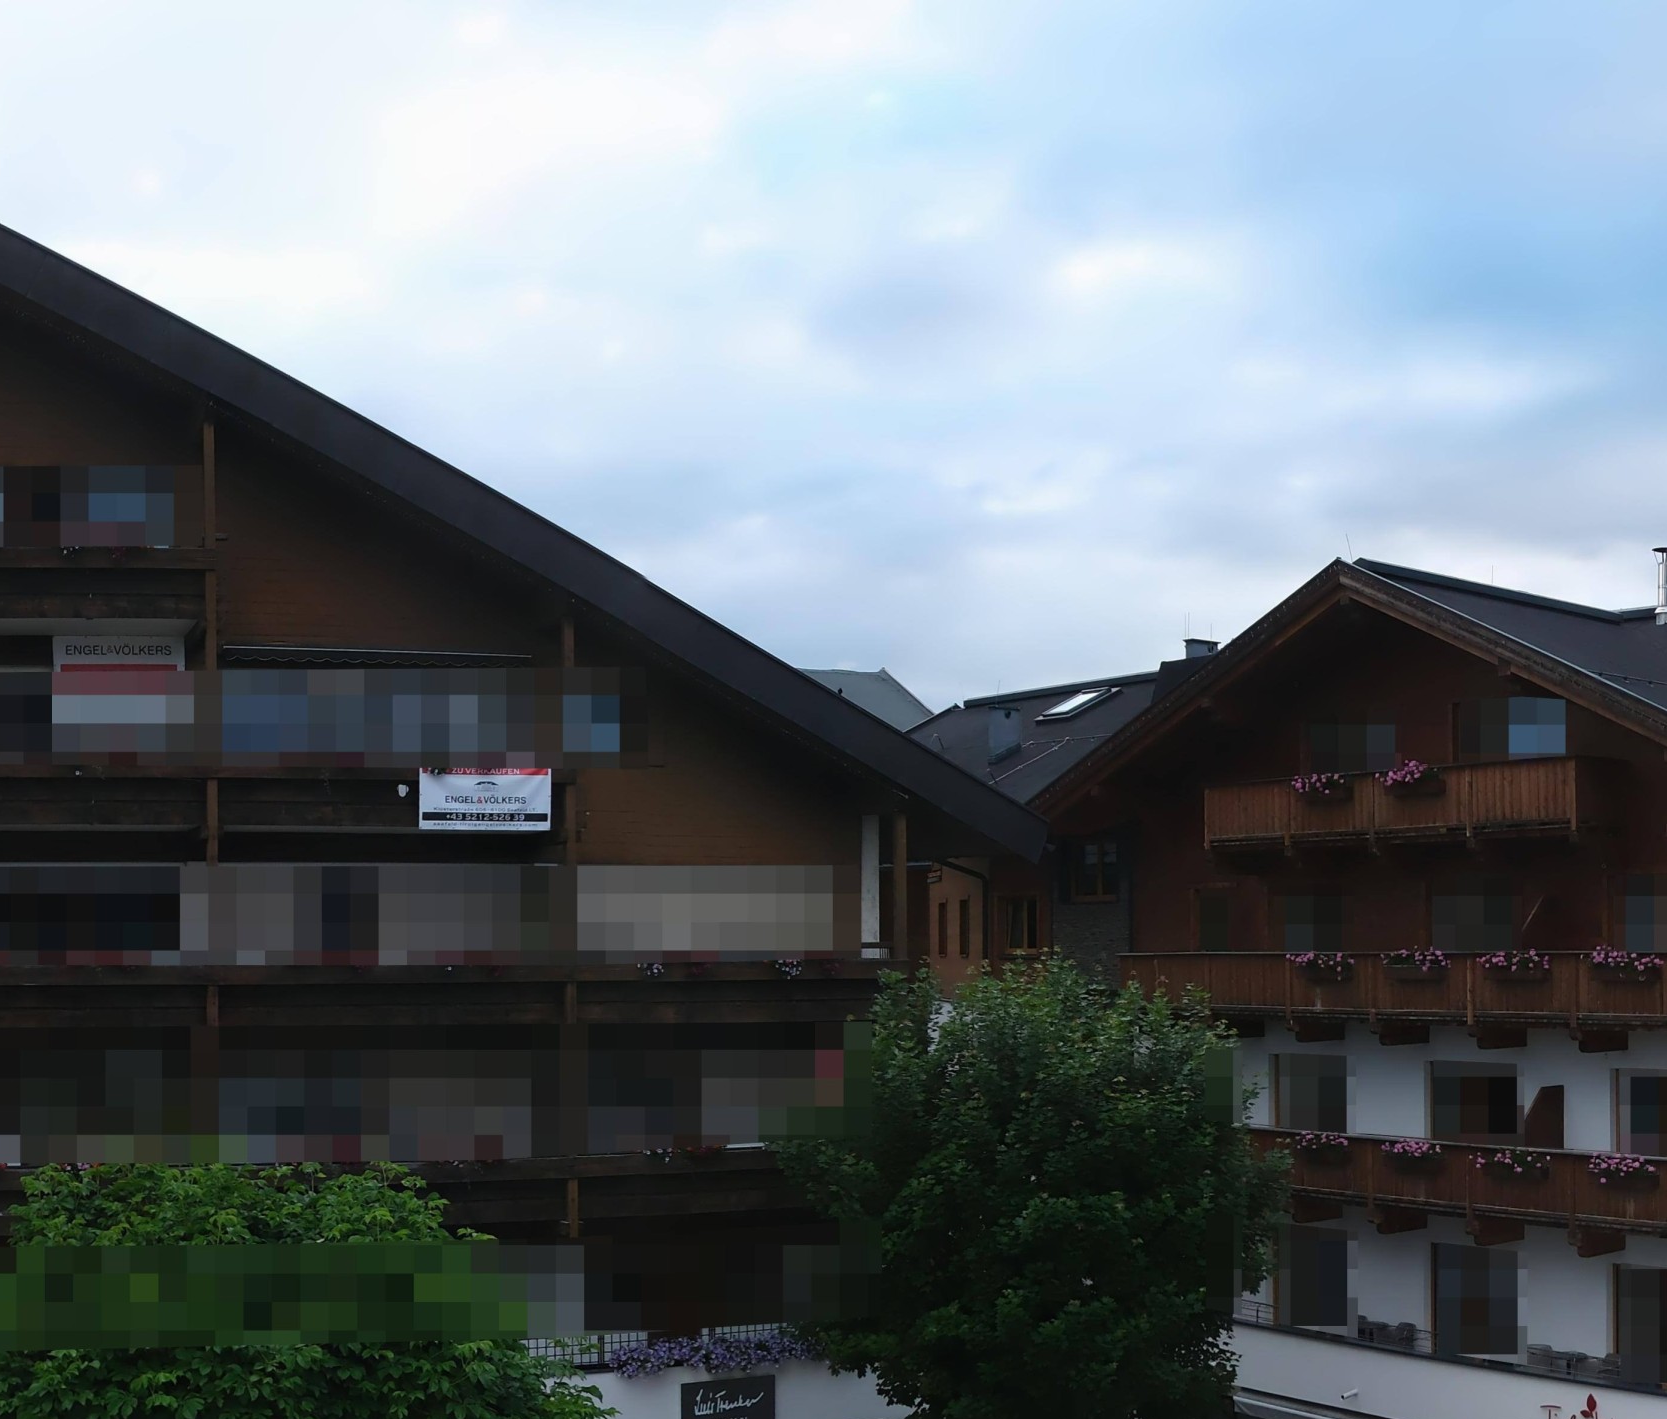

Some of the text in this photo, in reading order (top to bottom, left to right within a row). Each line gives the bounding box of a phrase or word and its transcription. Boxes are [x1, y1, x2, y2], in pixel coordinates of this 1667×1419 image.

[65, 642, 172, 656] ENGEL&VÖLKERS
[444, 794, 527, 805] ENGEL&VÖLKERS
[514, 813, 525, 821] 39
